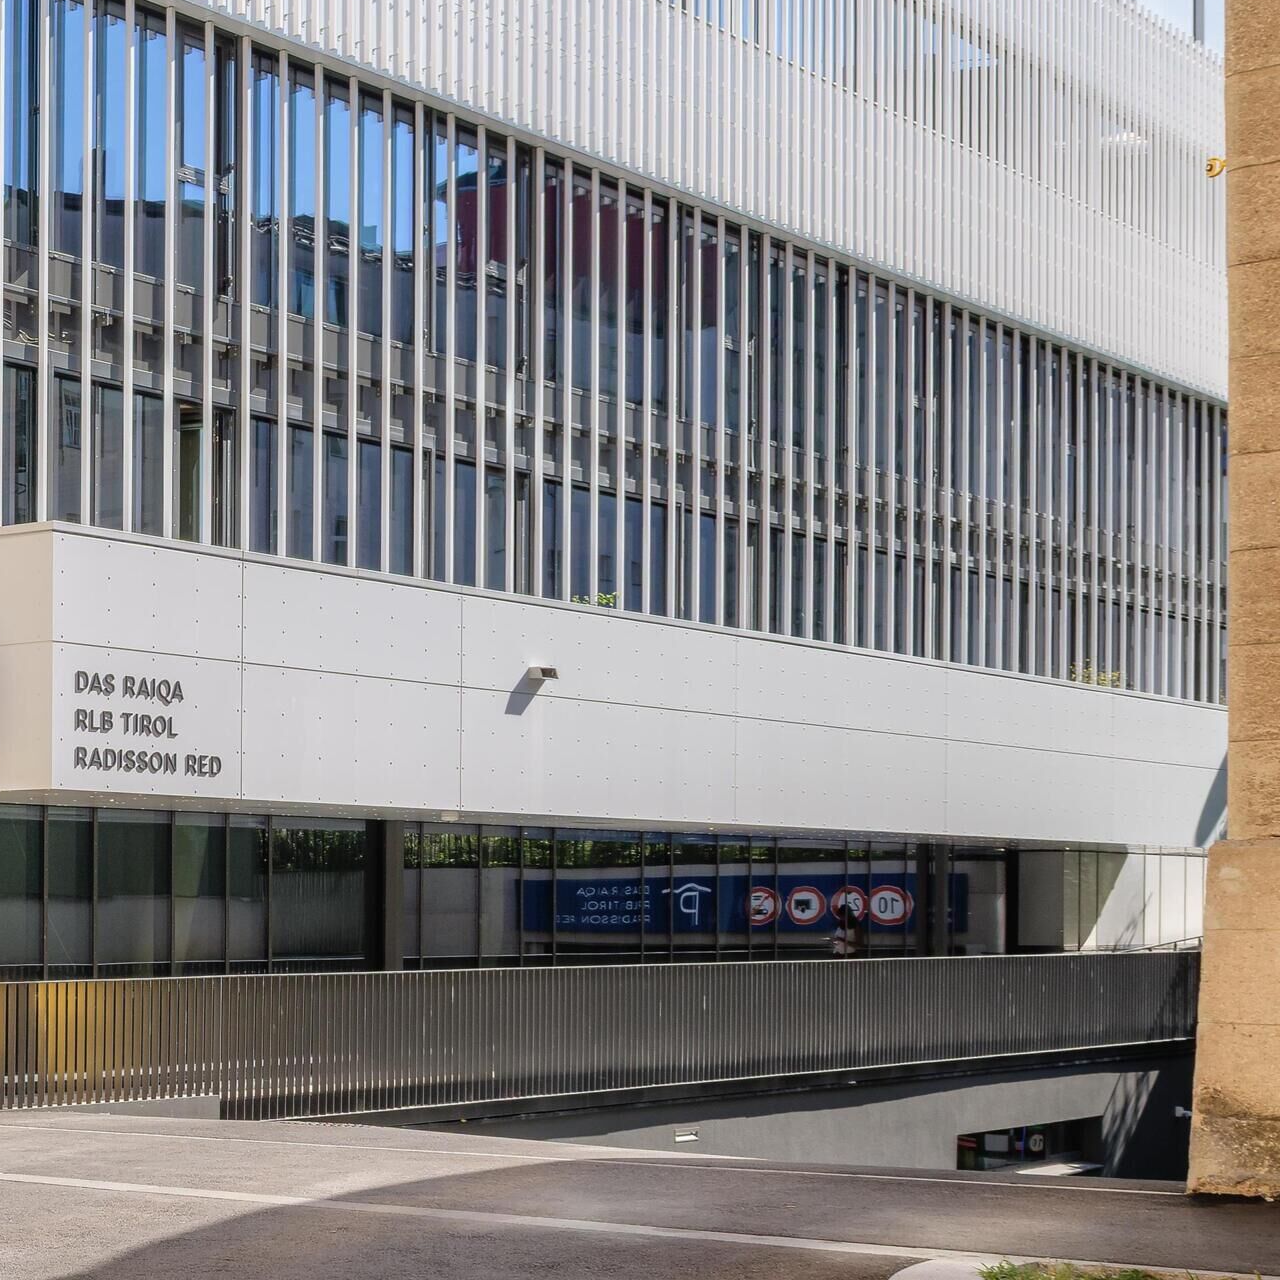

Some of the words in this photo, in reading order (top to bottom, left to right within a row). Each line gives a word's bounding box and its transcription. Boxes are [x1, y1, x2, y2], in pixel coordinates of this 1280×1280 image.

[74, 671, 115, 696] DAS
[122, 675, 184, 706] RAIQA
[74, 709, 113, 733] RLB
[120, 712, 178, 738] TIROL
[74, 746, 177, 774] RADISSON
[185, 754, 221, 777] RED
